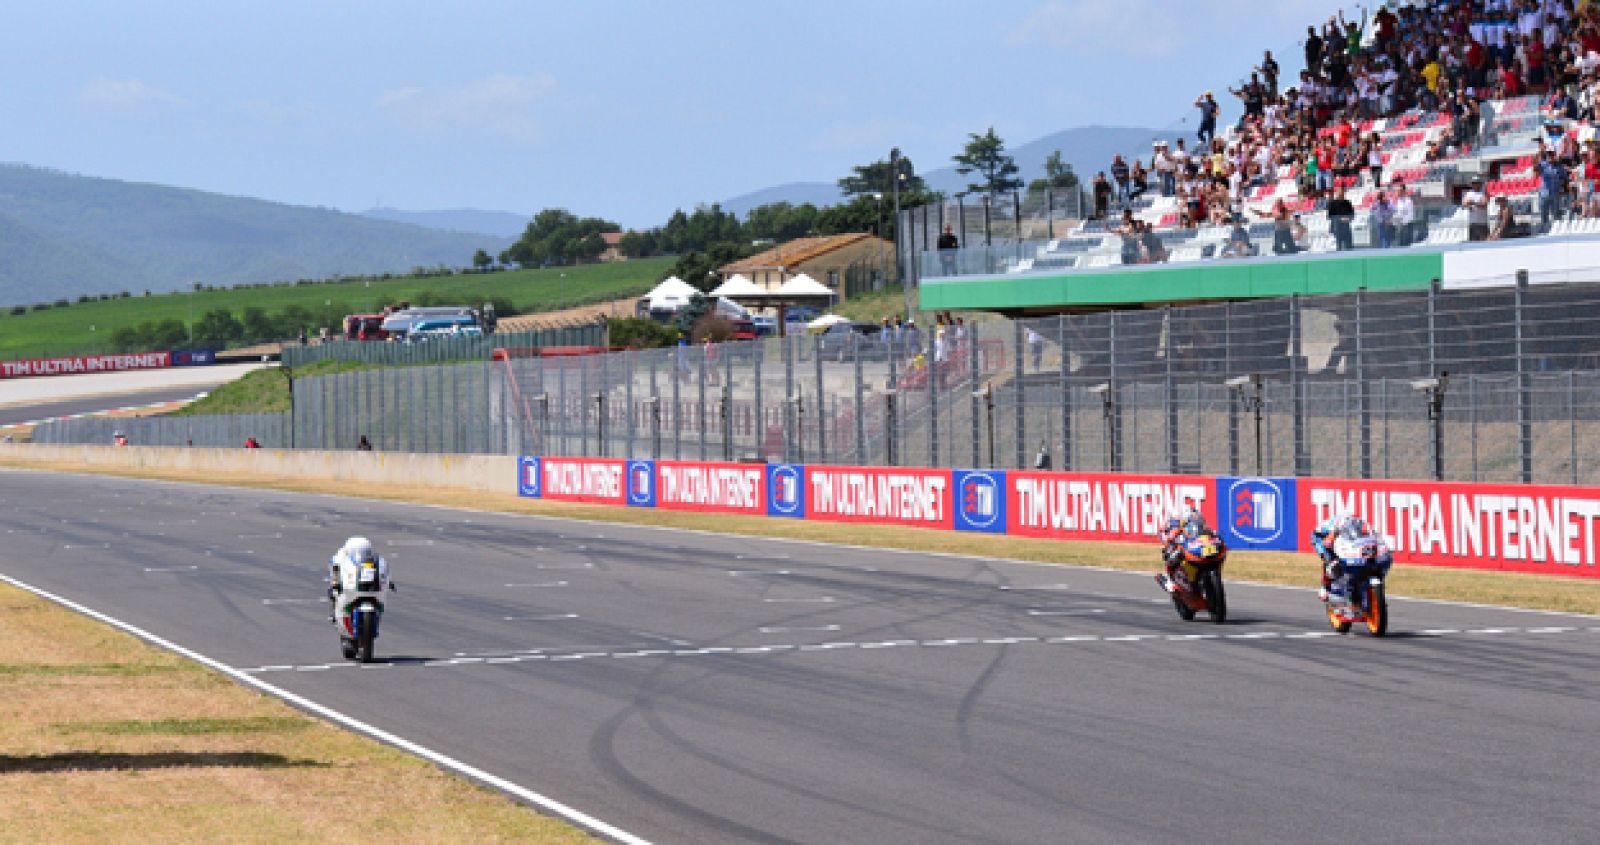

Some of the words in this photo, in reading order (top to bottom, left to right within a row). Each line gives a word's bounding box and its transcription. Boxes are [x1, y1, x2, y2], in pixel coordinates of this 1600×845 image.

[811, 472, 832, 513] TIM
[833, 473, 876, 516] ULTRA
[878, 474, 945, 521] INTERNET
[1016, 478, 1047, 527] TIM
[1050, 480, 1107, 532] ULTRA
[1360, 490, 1449, 555] ULTRA
[1450, 493, 1600, 566] INTERNET
